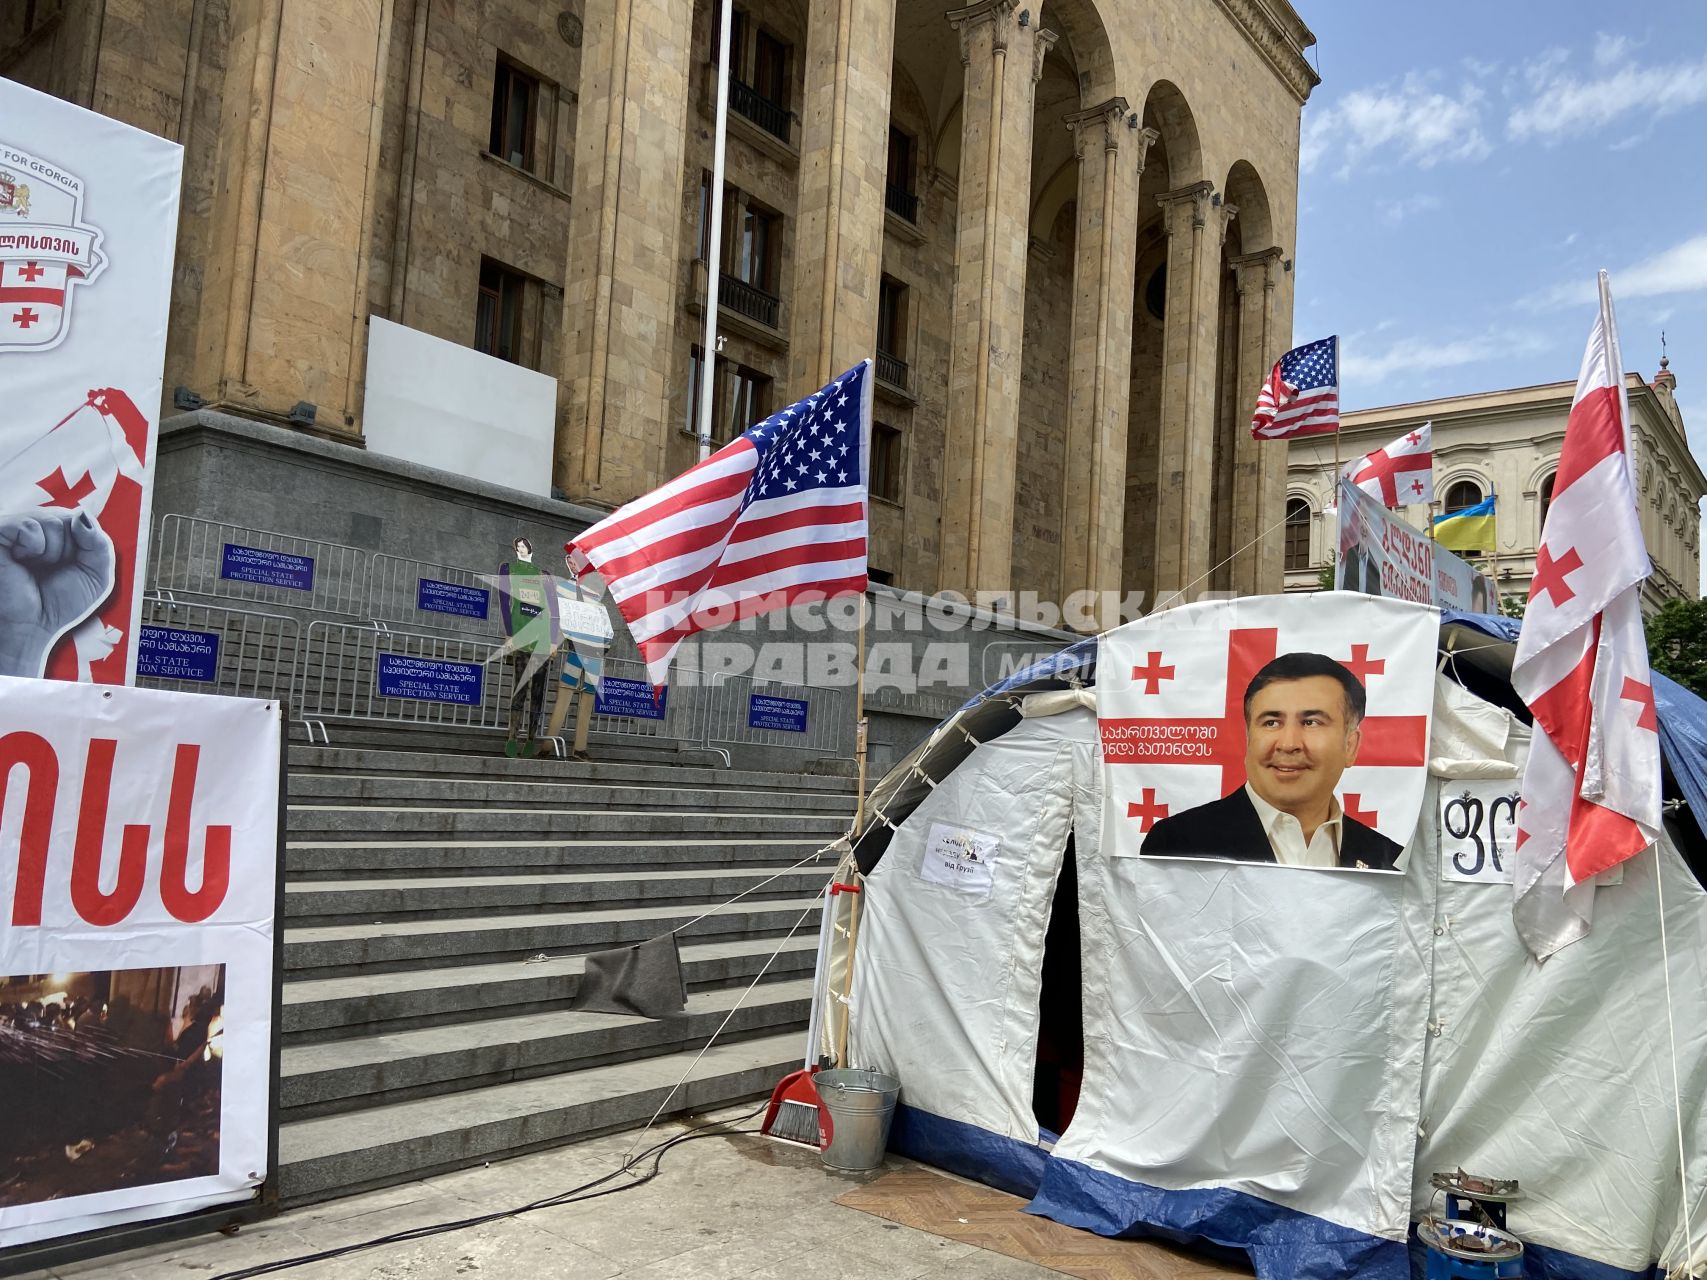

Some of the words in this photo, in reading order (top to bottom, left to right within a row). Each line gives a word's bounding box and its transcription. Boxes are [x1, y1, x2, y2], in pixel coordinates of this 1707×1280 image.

[4, 150, 28, 167] FOR
[30, 161, 79, 191] GEORGIA
[230, 571, 274, 583] PROTECTION
[275, 578, 304, 588] SERVICE
[241, 566, 269, 576] SPECIAL
[271, 571, 294, 580] STATE
[456, 602, 474, 610] STATE
[170, 632, 206, 643] დაცვის
[157, 641, 212, 654] სამსახური
[154, 655, 190, 667] STATE
[160, 665, 204, 677] SERVICE
[444, 663, 472, 674] დაცვის
[435, 672, 476, 683] სამსახური
[399, 680, 431, 690] SPECIAL
[433, 683, 460, 693] STATE
[386, 686, 437, 698] PROTECTION
[438, 691, 470, 702] SERVICE
[1100, 726, 1218, 739] საქართველოში
[1137, 742, 1213, 756] გათენდეს
